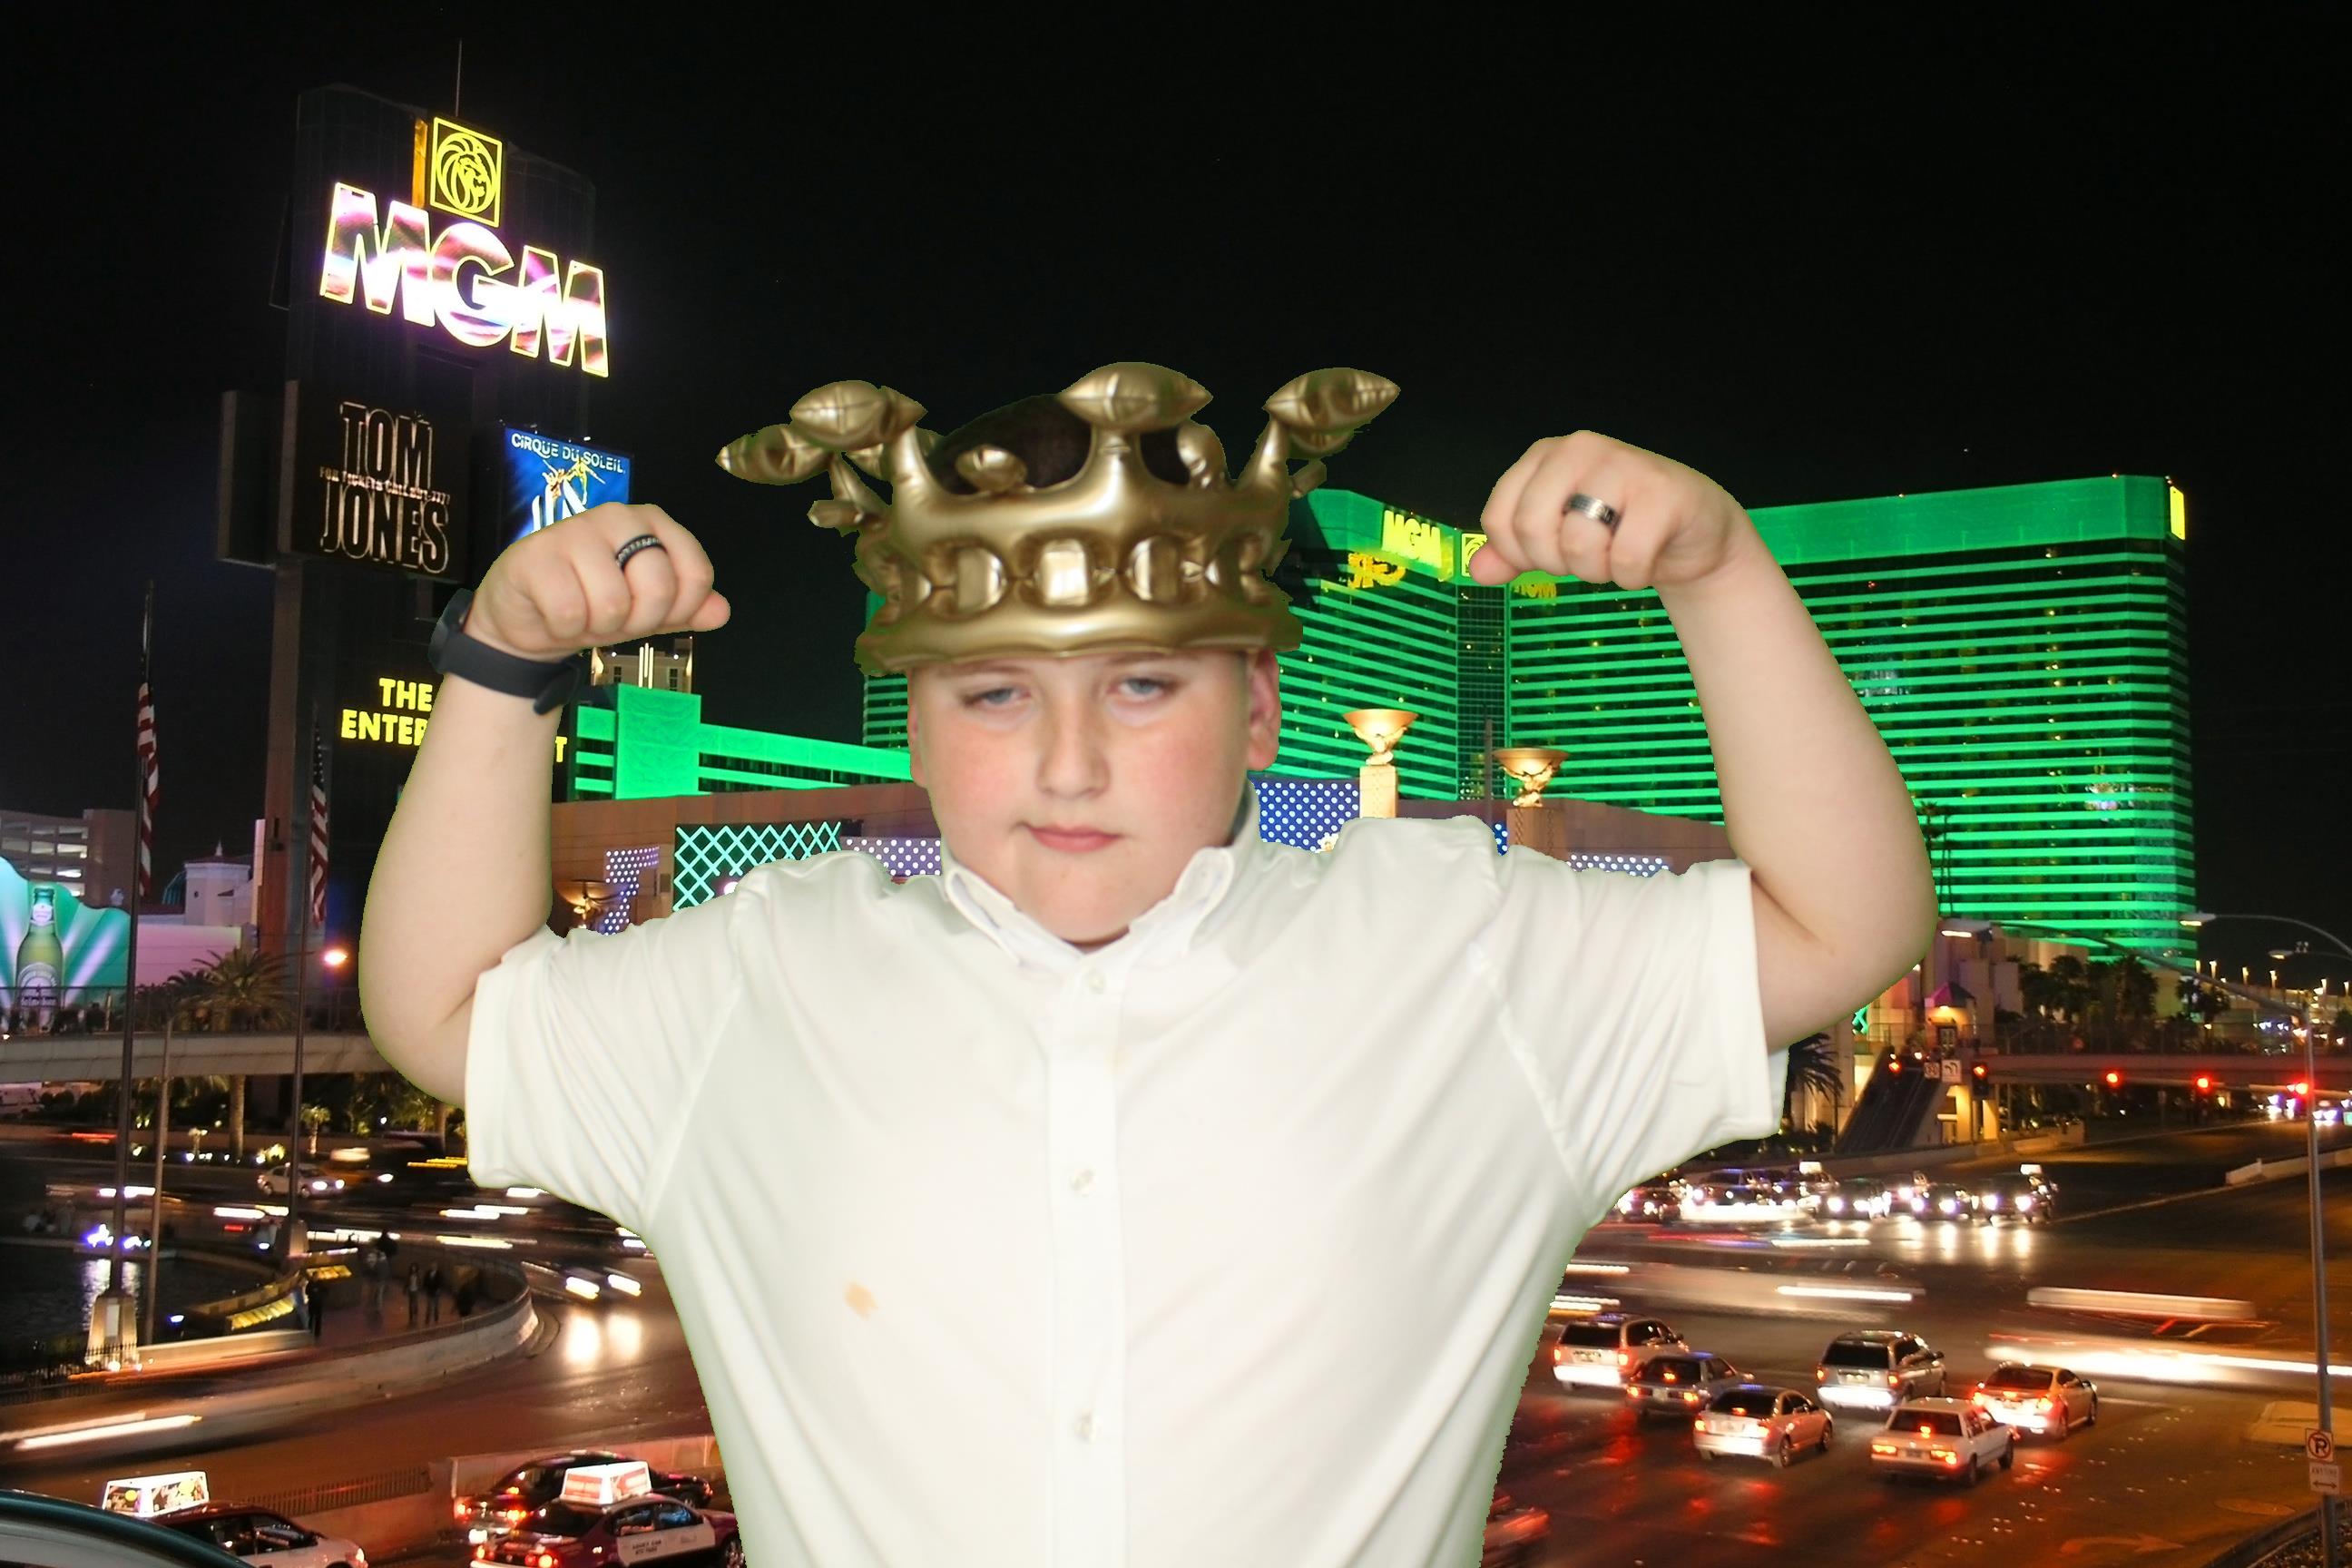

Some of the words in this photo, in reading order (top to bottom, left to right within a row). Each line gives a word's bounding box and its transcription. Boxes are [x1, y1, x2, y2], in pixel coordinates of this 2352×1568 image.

[320, 181, 609, 377] MGM
[340, 401, 433, 489] TOM
[320, 482, 450, 574] JONES
[1381, 509, 1442, 569] MGM
[378, 678, 433, 712] THE
